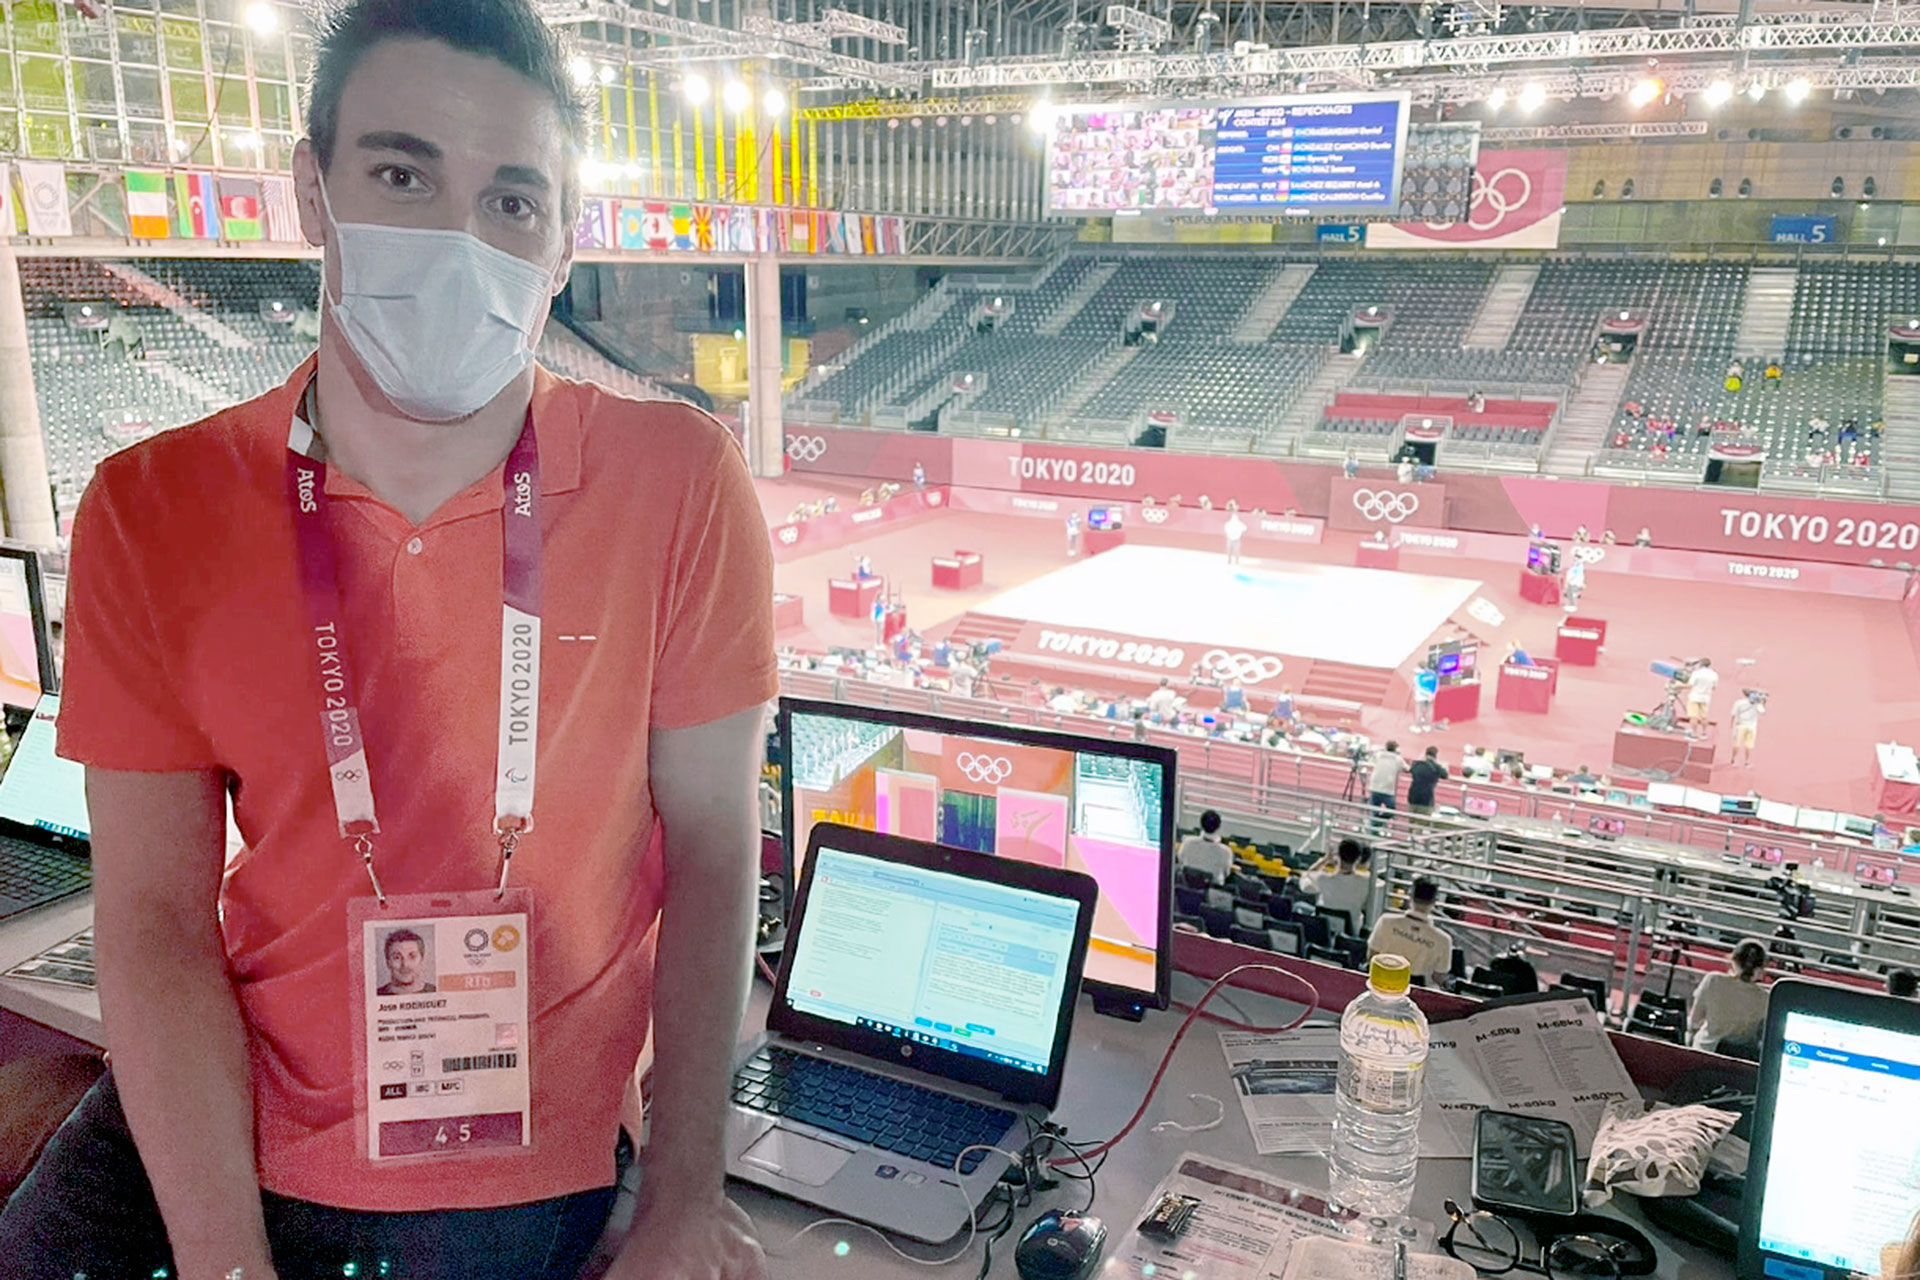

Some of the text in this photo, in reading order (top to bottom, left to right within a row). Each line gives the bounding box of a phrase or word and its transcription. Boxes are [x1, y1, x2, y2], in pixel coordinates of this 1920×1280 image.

[1348, 225, 1361, 242] 5
[1812, 225, 1827, 243] 5
[1008, 455, 1136, 487] TOKYO 2020
[297, 467, 317, 514] Atos
[513, 471, 532, 518] Atos
[1721, 509, 1920, 550] TOKYO 2020
[1728, 562, 1800, 580] TOKYO 2020
[1037, 629, 1185, 669] TOKYO 2020
[315, 622, 354, 748] TOKYO 2020
[508, 623, 532, 746] TOKYO 2020
[384, 1086, 403, 1096] ALL
[435, 1124, 471, 1144] 4 5
